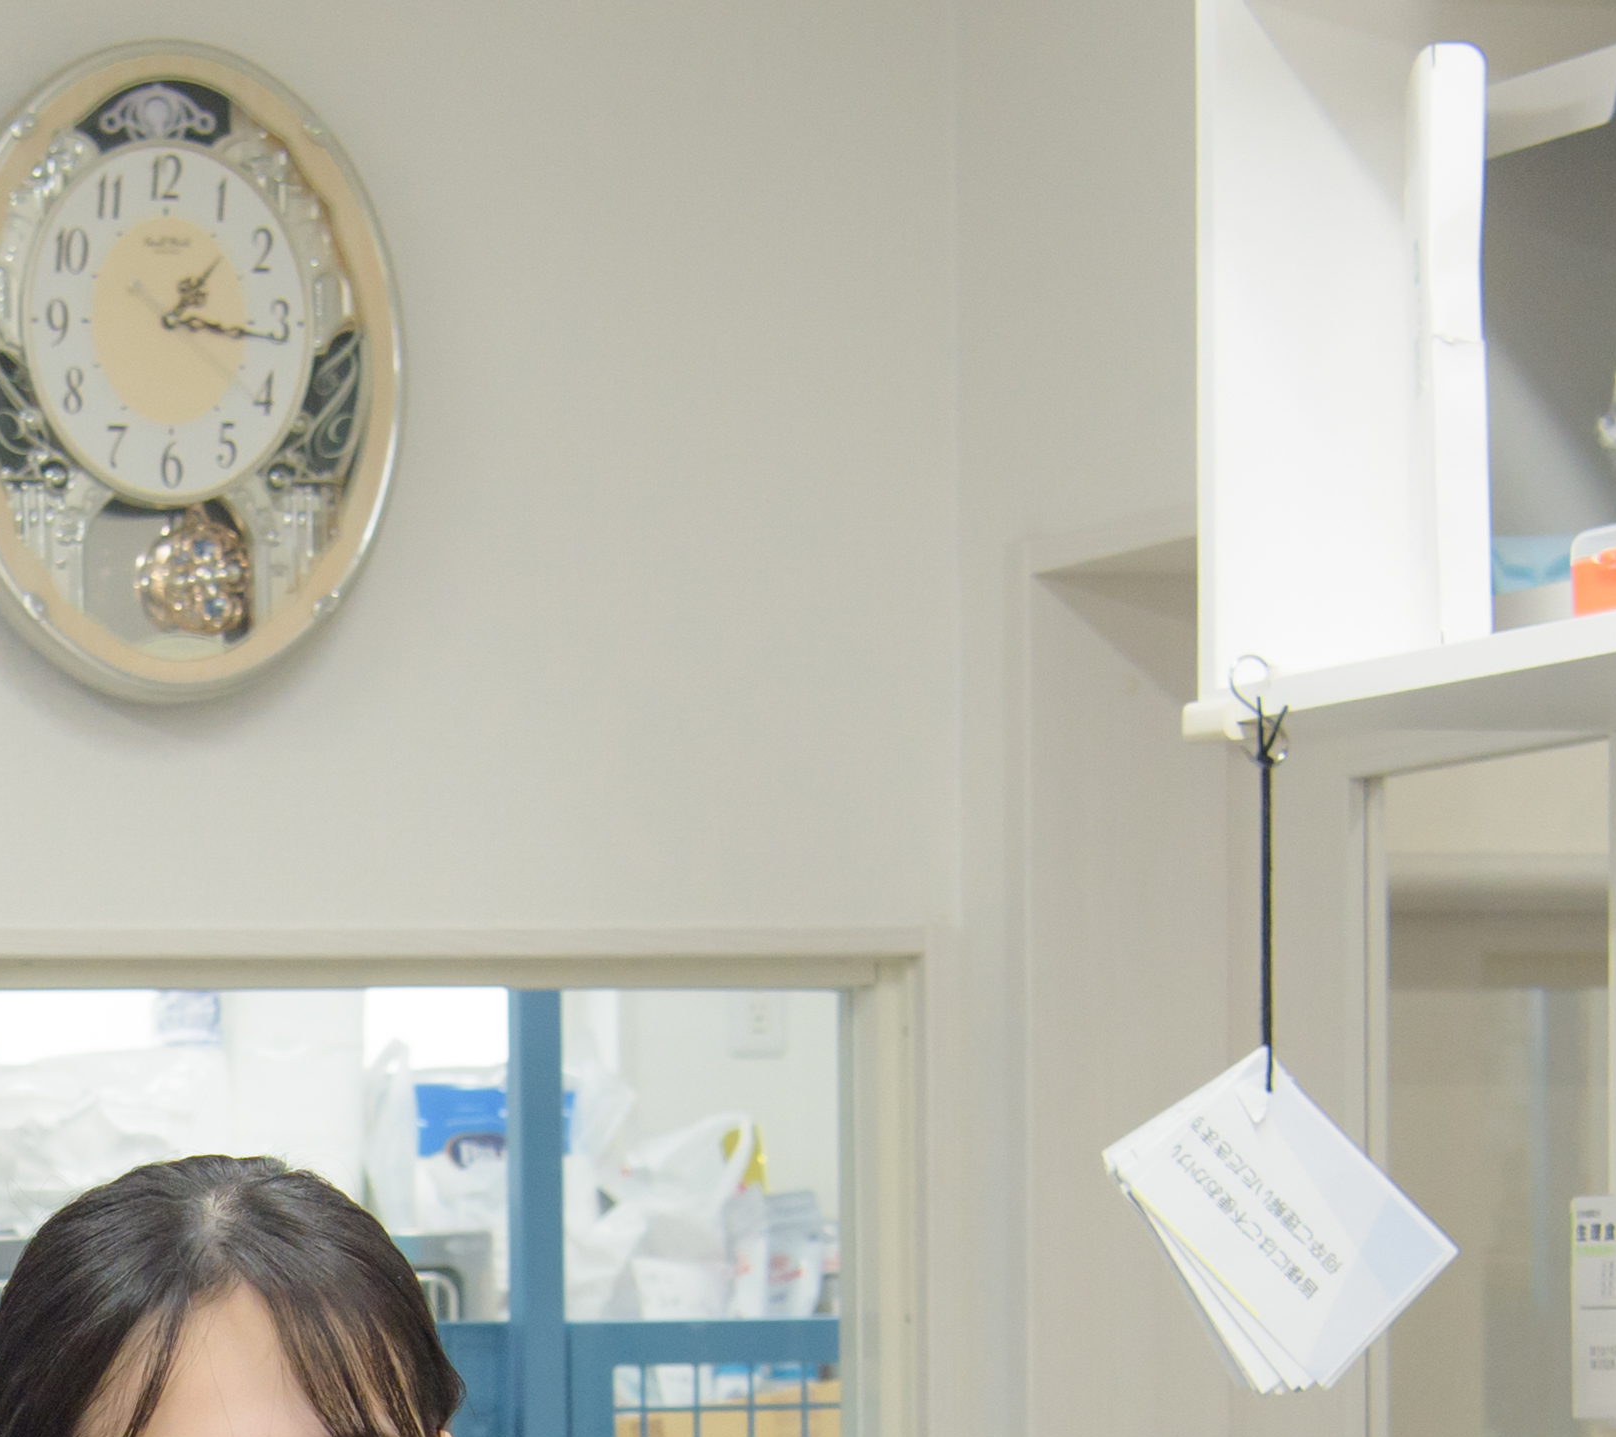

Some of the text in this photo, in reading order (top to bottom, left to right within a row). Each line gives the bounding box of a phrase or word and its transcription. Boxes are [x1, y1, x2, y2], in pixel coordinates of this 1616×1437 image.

[97, 173, 122, 220] 11
[150, 154, 181, 201] 12
[216, 178, 227, 222] 1
[54, 229, 88, 276] 10
[251, 227, 274, 274] 2
[47, 299, 68, 346] 9
[271, 300, 291, 344] 3
[63, 367, 85, 414] 8
[253, 371, 275, 416] 4
[107, 425, 128, 468] 7
[161, 441, 182, 489] 6
[216, 422, 237, 468] 5
